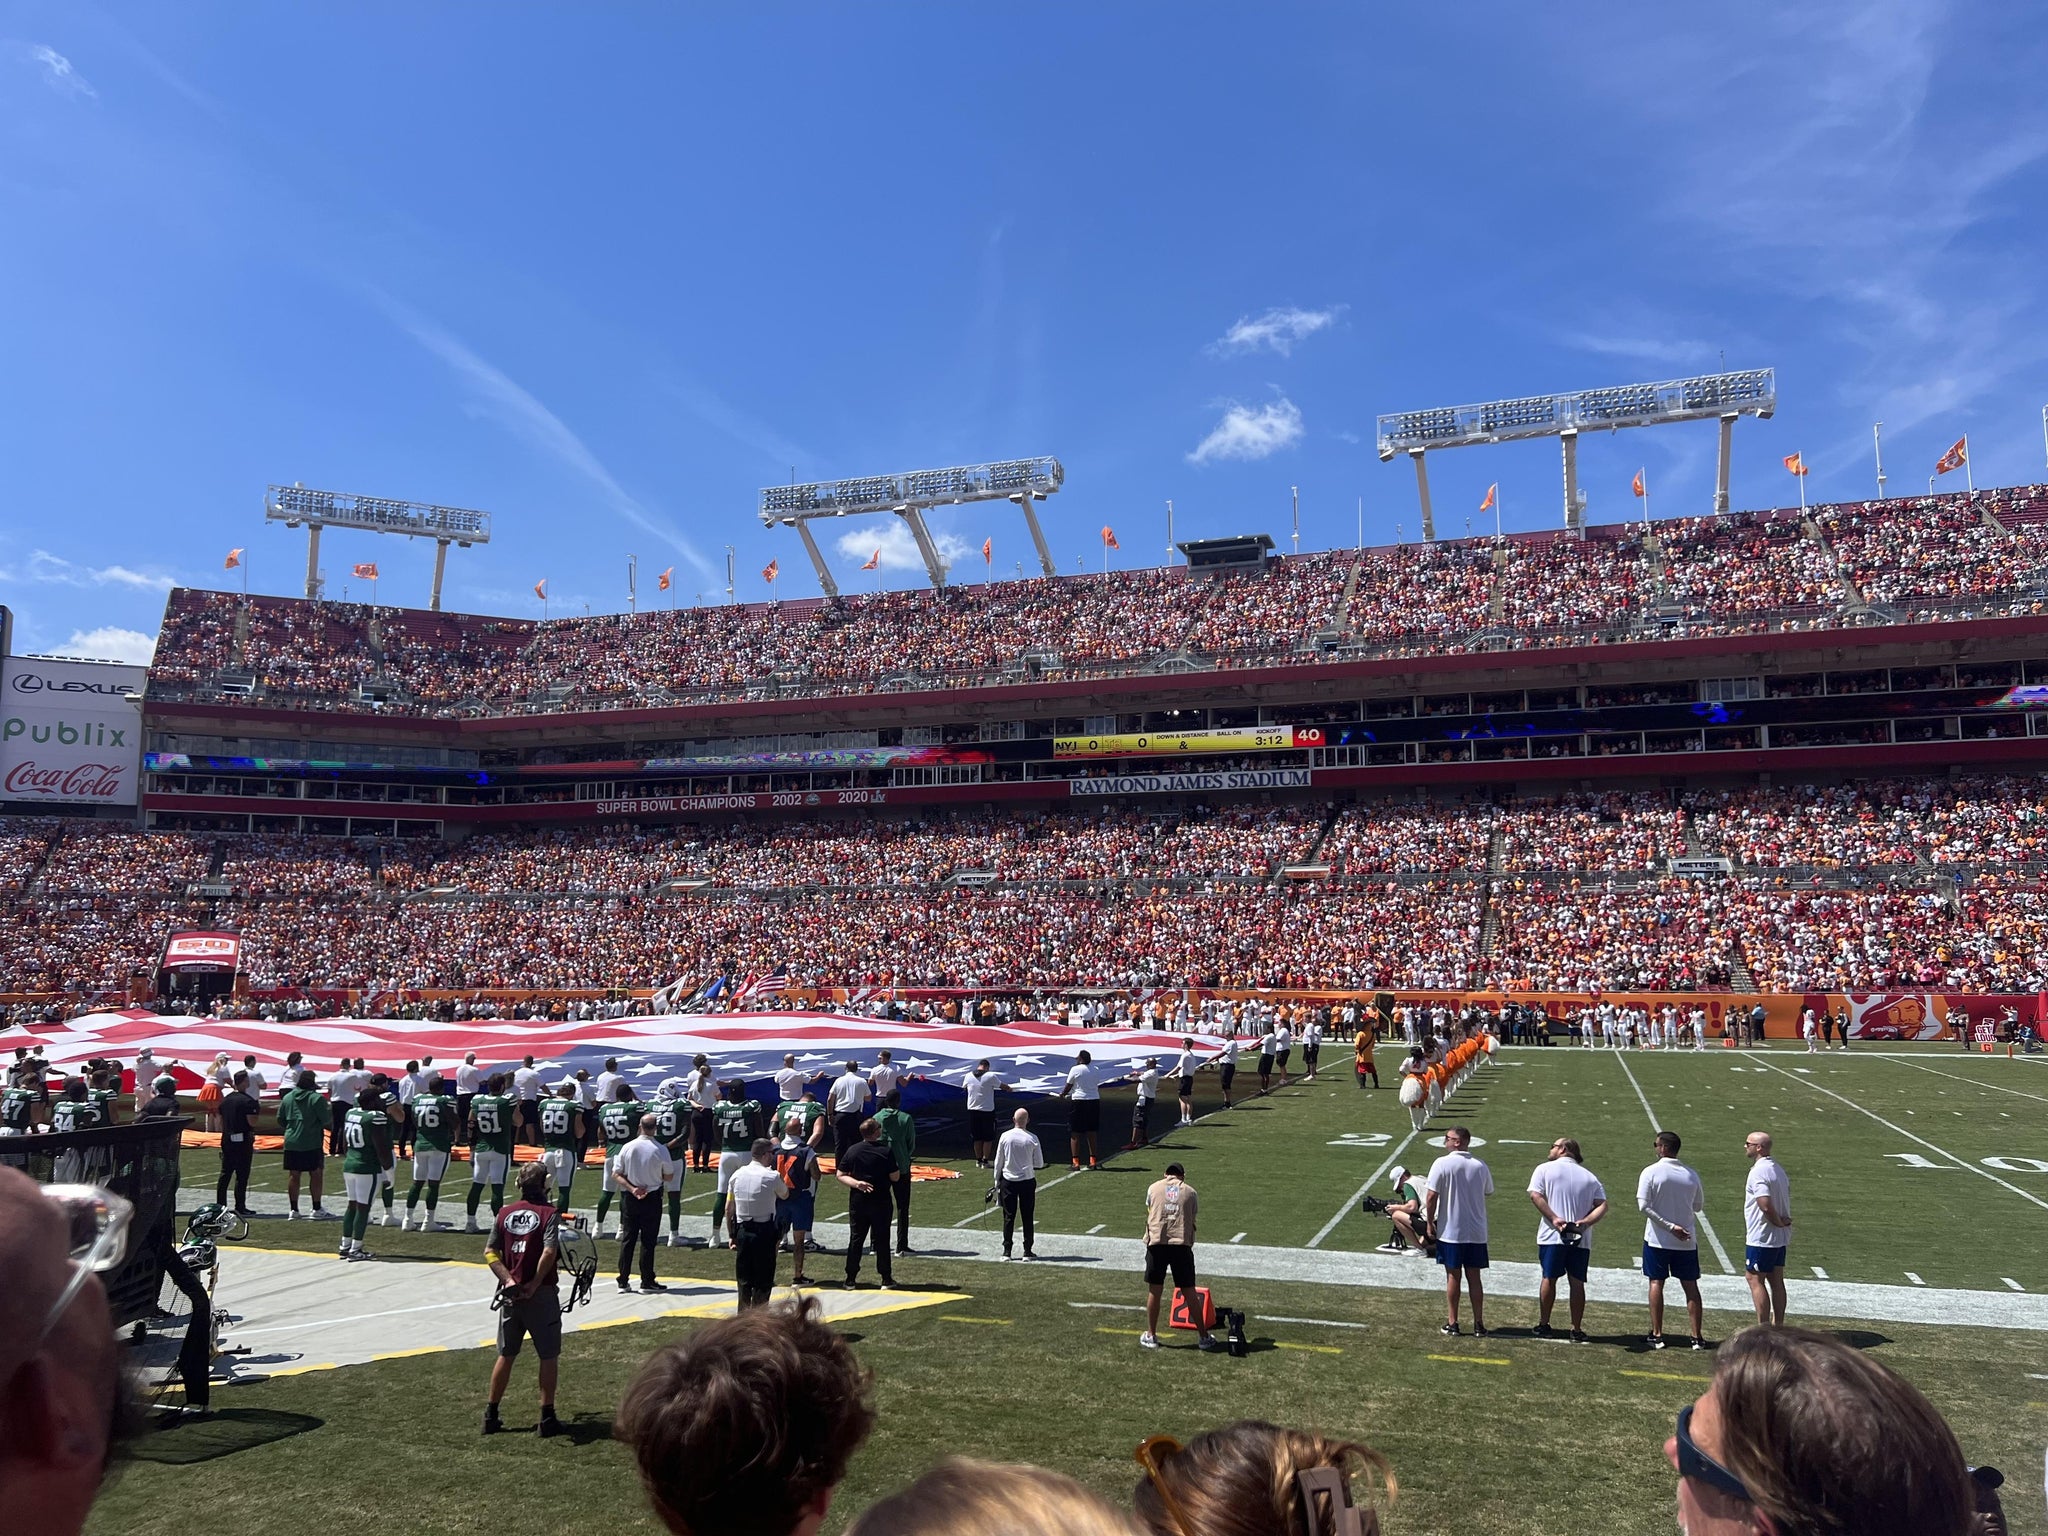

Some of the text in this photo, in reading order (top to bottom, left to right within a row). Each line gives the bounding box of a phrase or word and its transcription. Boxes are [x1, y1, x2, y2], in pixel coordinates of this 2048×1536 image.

[47, 680, 135, 696] LEXUS
[3, 718, 126, 748] Publix
[1181, 731, 1209, 739] DISTANCE
[1256, 727, 1282, 735] KICKOFF
[1298, 728, 1320, 742] 40
[1055, 740, 1098, 752] NYJ 0
[1137, 737, 1147, 748] 0
[1179, 741, 1188, 750] &
[1255, 735, 1283, 746] 3:12
[5, 761, 128, 797] Coca-Cola
[1071, 770, 1310, 795] RAYMOND JAMES STADIUM
[596, 795, 756, 814] SUPER BOWL CHAMPIONS
[772, 793, 802, 806] 2002
[838, 790, 868, 803] 2020
[180, 965, 218, 973] GEICO
[1976, 1025, 1991, 1034] GET
[1, 1099, 26, 1120] 47
[414, 1105, 440, 1128] 76
[477, 1111, 502, 1133] 61
[542, 1110, 569, 1134] 89
[602, 1115, 630, 1139] 65
[718, 1118, 749, 1138] 74
[344, 1121, 366, 1148] 70
[776, 1154, 798, 1189] K
[511, 1214, 533, 1226] FOX
